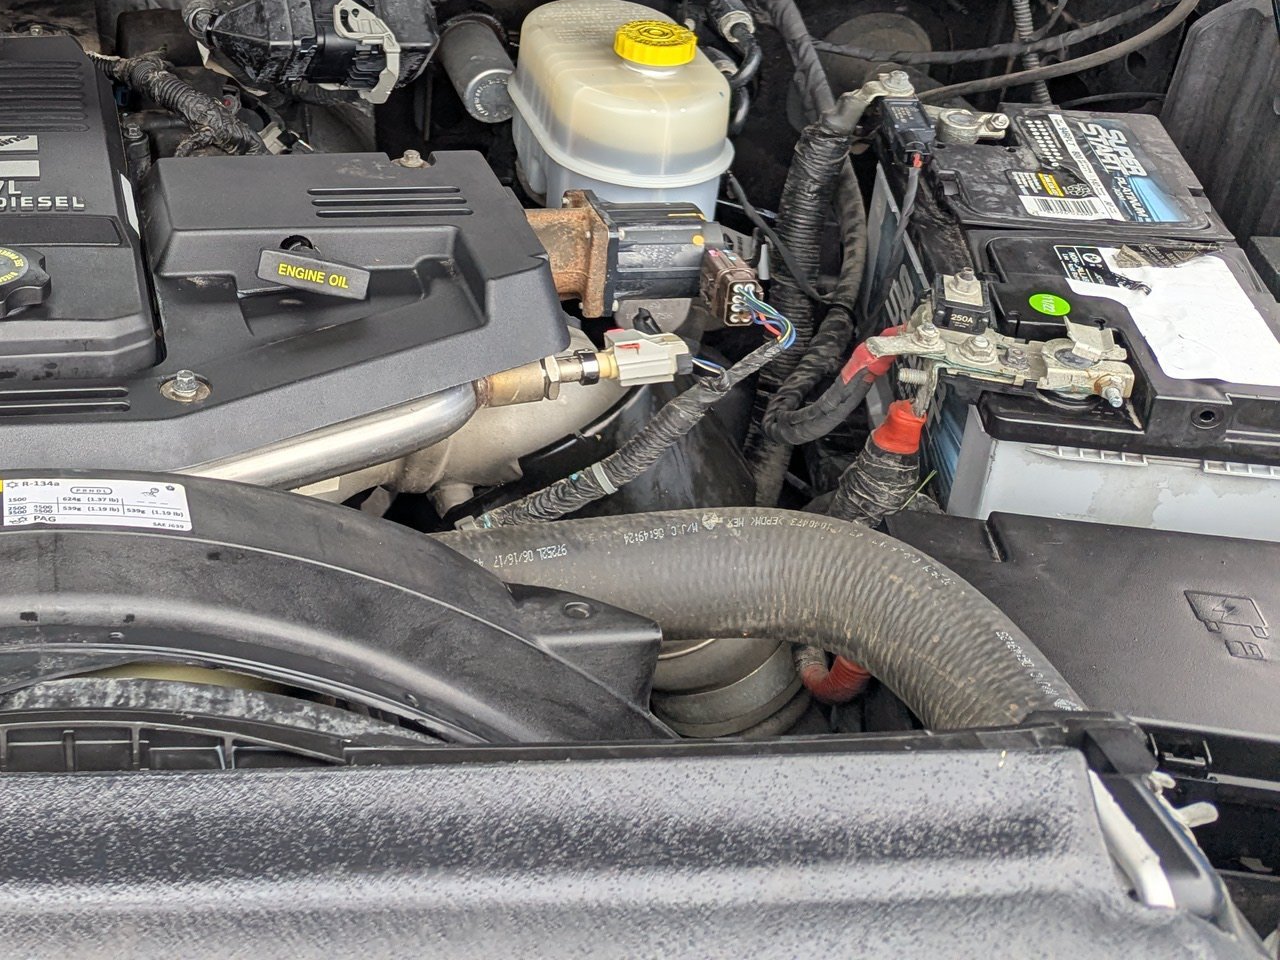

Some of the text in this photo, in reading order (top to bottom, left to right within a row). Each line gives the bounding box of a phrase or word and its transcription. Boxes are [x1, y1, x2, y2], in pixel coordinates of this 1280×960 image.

[1108, 129, 1148, 176] SUPER
[1077, 121, 1149, 218] START PLATINUM
[278, 263, 349, 289] ENGINE OIL
[950, 313, 974, 324] 250A
[493, 548, 534, 568] 06/16/17
